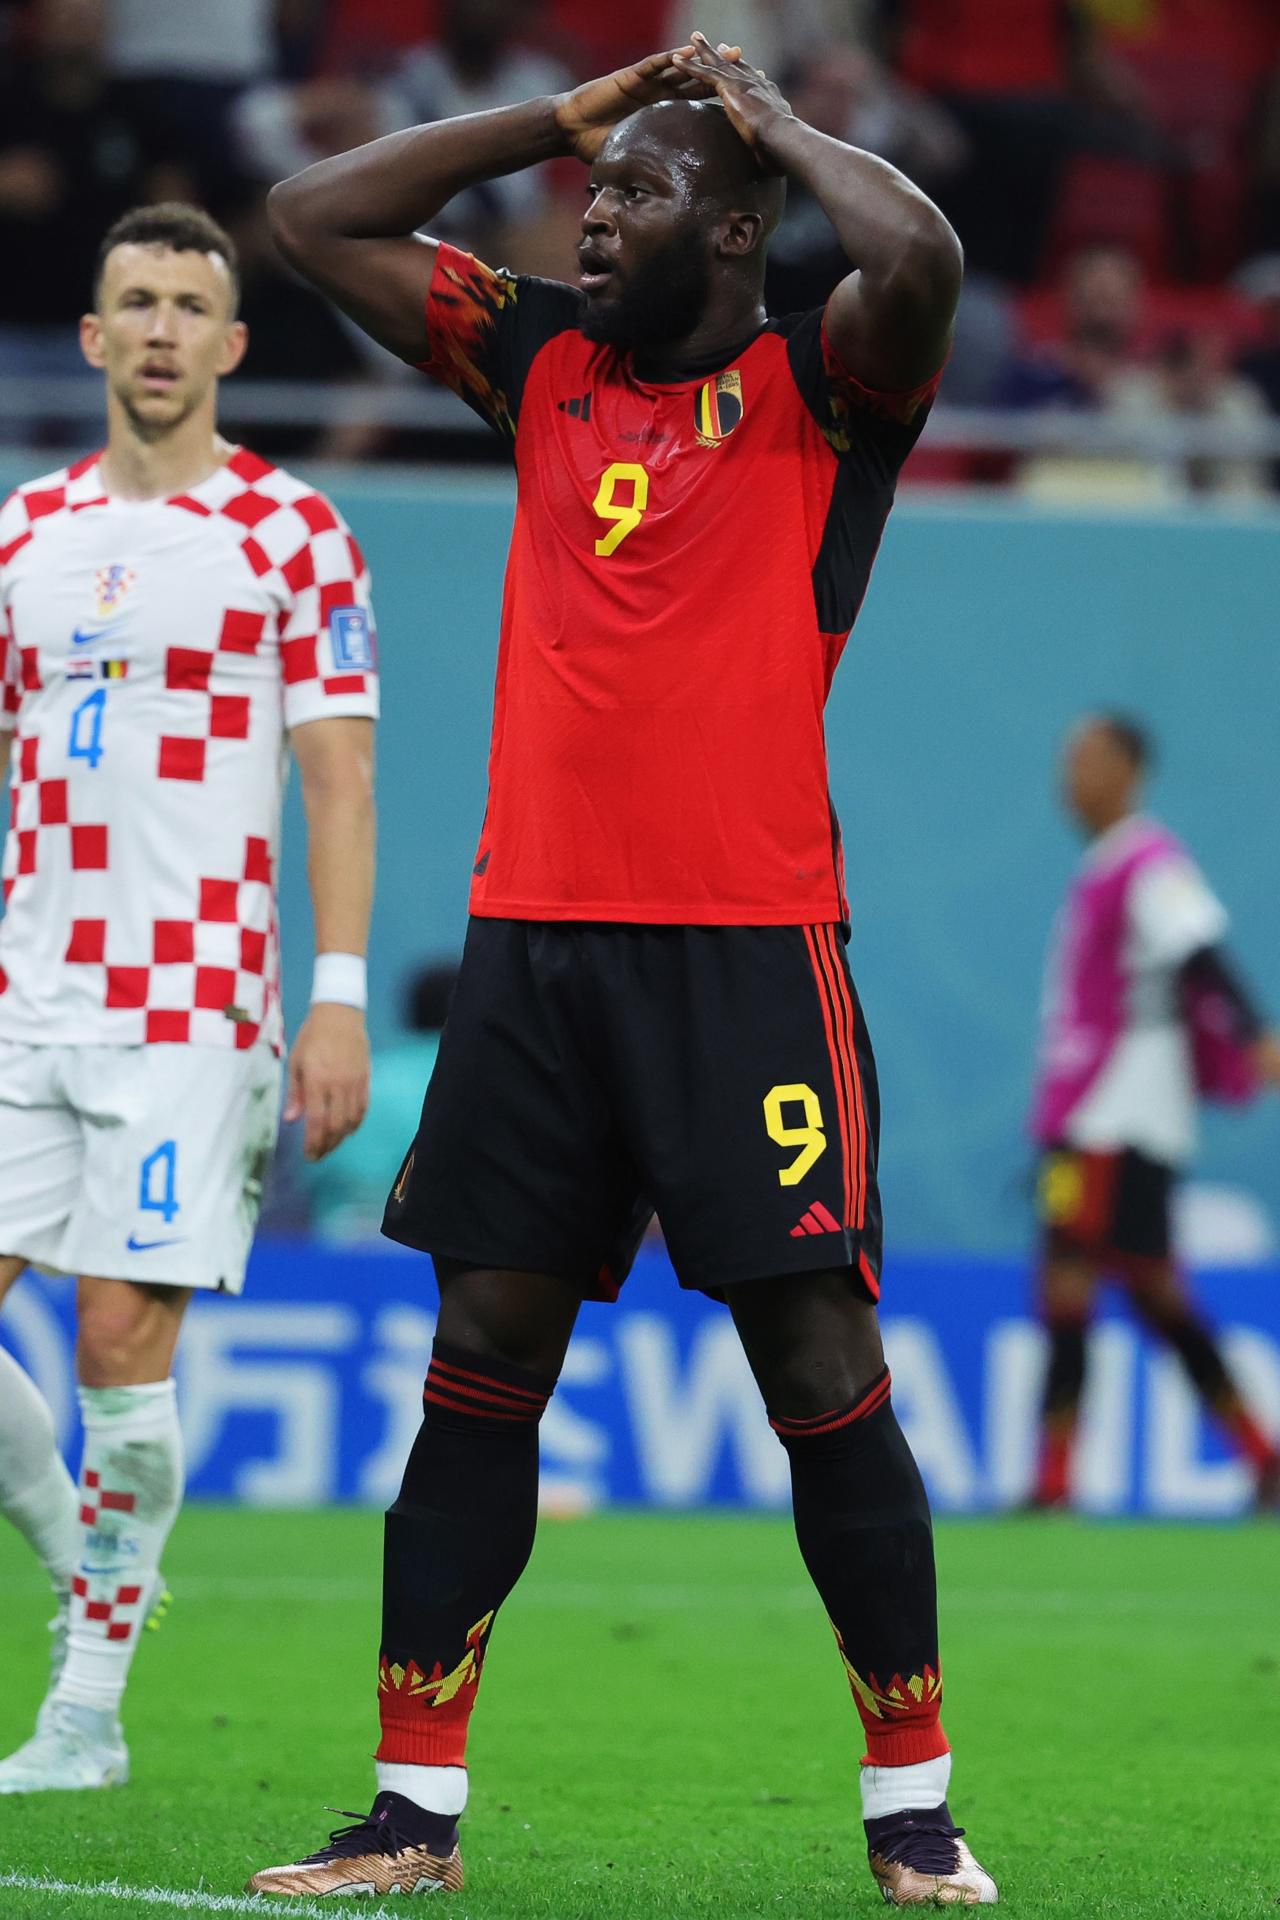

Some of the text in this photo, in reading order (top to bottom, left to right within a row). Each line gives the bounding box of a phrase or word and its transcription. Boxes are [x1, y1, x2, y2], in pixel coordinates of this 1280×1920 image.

[593, 463, 649, 556] 9
[67, 687, 107, 769] 4
[763, 1083, 827, 1186] 9
[138, 1139, 180, 1223] 4
